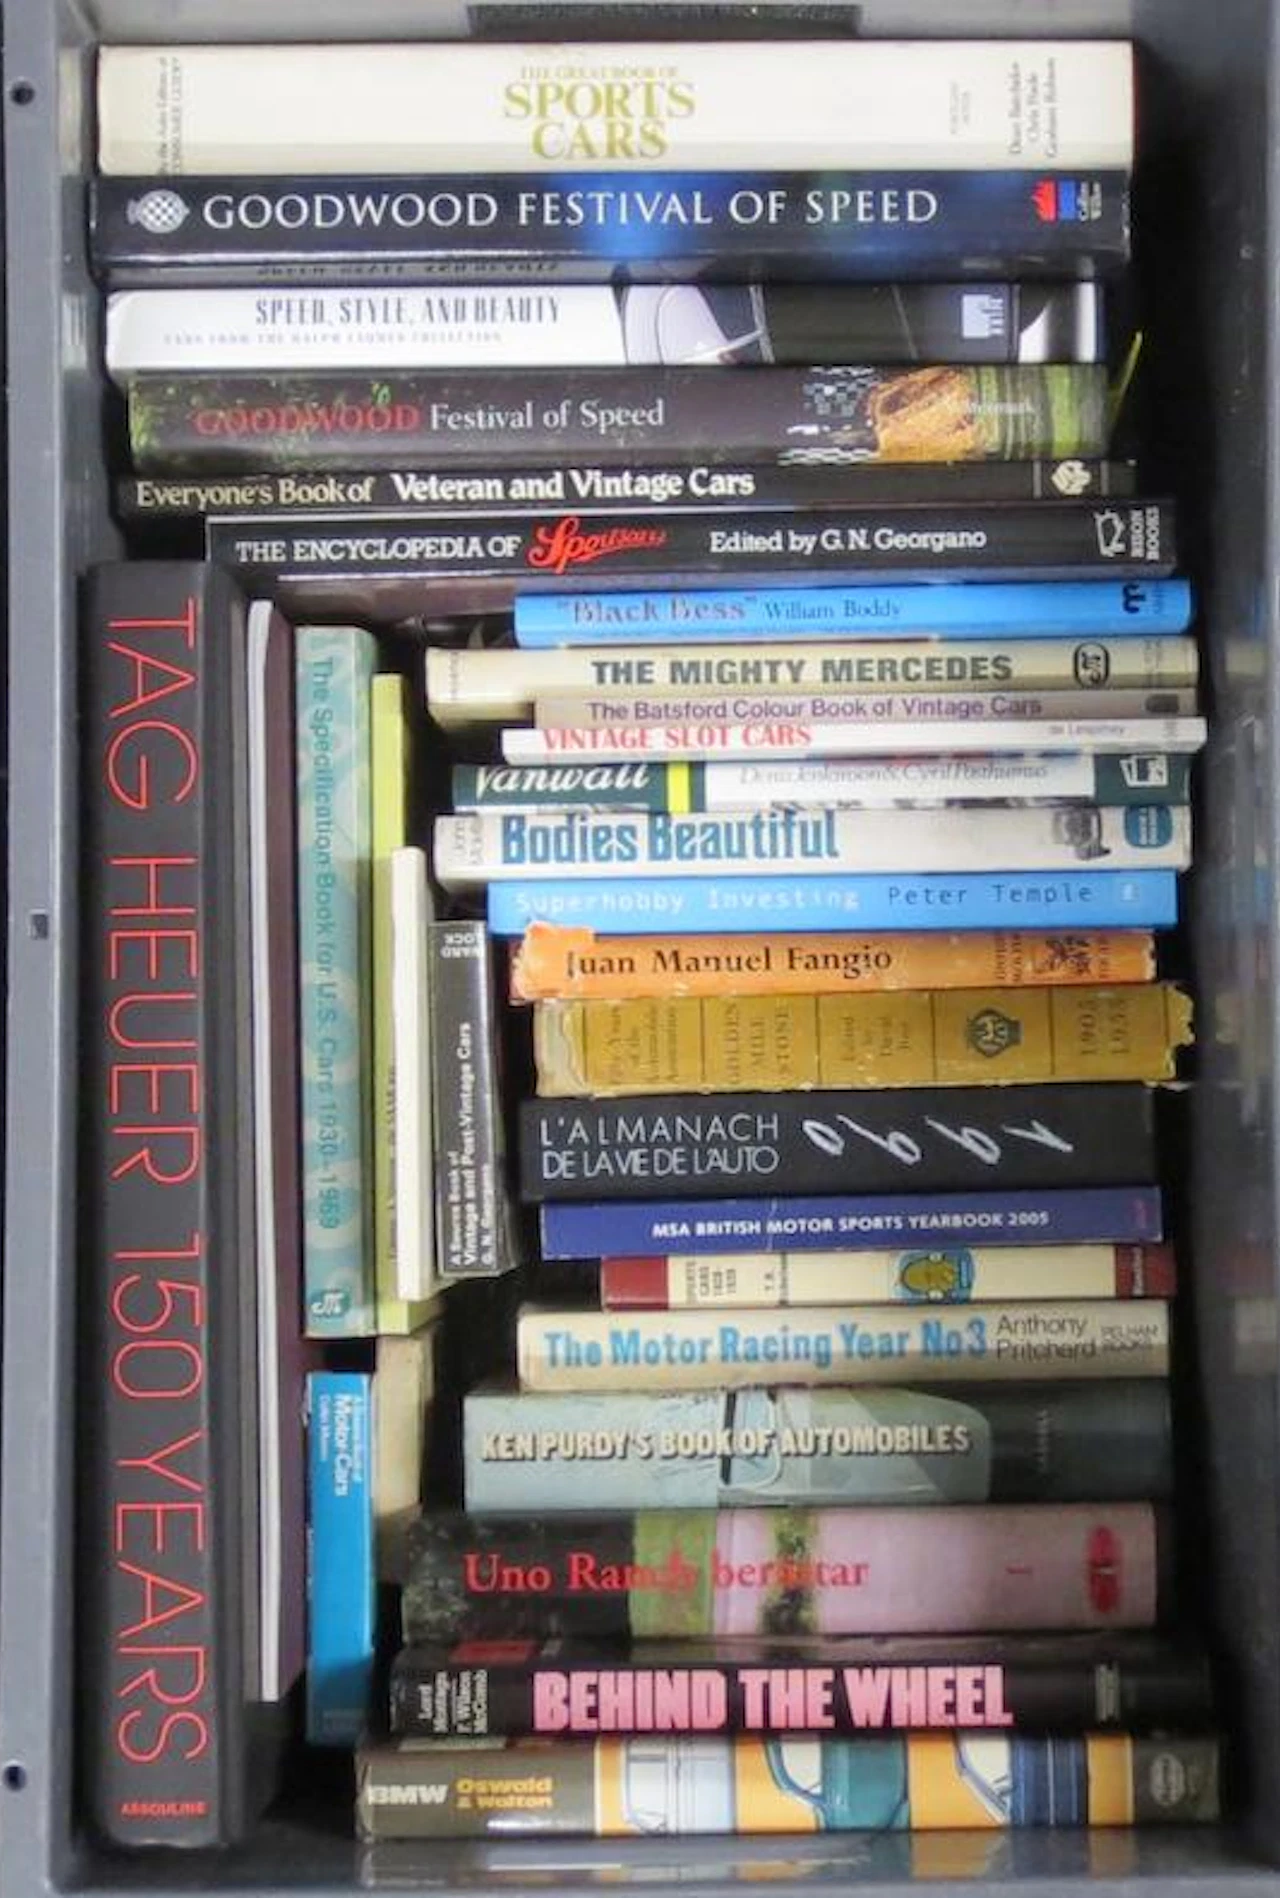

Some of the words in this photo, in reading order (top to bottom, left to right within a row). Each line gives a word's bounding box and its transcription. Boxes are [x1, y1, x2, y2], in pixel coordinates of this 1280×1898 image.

[203, 193, 498, 230] GOODWOOD
[518, 191, 713, 226] FESTIVAL
[729, 190, 787, 224] OF
[806, 190, 938, 224] SPEED
[137, 480, 274, 509] Everyone's
[279, 479, 341, 503] Book
[346, 477, 375, 501] of
[390, 472, 505, 501] Veteran
[510, 472, 563, 498] and
[570, 469, 683, 505] Vintage
[689, 469, 755, 496] Cars
[593, 661, 654, 684] THE
[670, 659, 805, 684] MIGHTY
[822, 655, 1013, 683] MERCEDES
[106, 597, 198, 810] TAG
[588, 702, 628, 721] The
[634, 700, 727, 720] Batsford
[733, 699, 803, 719] Colour
[811, 698, 866, 718] Book
[872, 697, 894, 717] of
[903, 697, 985, 721] Vintage
[990, 696, 1042, 716] Cars
[543, 729, 652, 751] VINTAGE
[666, 727, 730, 749] SLOT
[742, 726, 812, 747] CARS
[501, 814, 638, 865] Bodies
[648, 810, 839, 862] Beautiful
[514, 889, 687, 914] Superhobby
[707, 887, 860, 911] Investing
[888, 884, 968, 904] Peter
[992, 882, 1094, 906] Temple
[108, 857, 199, 1182] HEUER
[652, 1222, 692, 1238] MSA
[697, 1219, 761, 1235] BRITISH
[766, 1218, 833, 1234] MOTOR
[839, 1216, 903, 1232] SPORTS
[908, 1214, 1004, 1230] YEARBOOK
[1008, 1212, 1049, 1228] 2005
[111, 1230, 203, 1398] 150
[996, 1315, 1087, 1339] Anthony
[481, 1430, 539, 1462] KEN
[541, 1428, 652, 1461] PURDY'S
[660, 1428, 734, 1458] BOOK
[738, 1428, 776, 1457] OF
[779, 1425, 970, 1456] AUTOMOBILES
[114, 1429, 208, 1763] YEARS
[534, 1670, 726, 1732] BEHIND
[737, 1668, 839, 1730] THE
[844, 1665, 1014, 1728] WHEEL
[368, 1785, 448, 1805] BMW
[456, 1778, 553, 1795] Oswald
